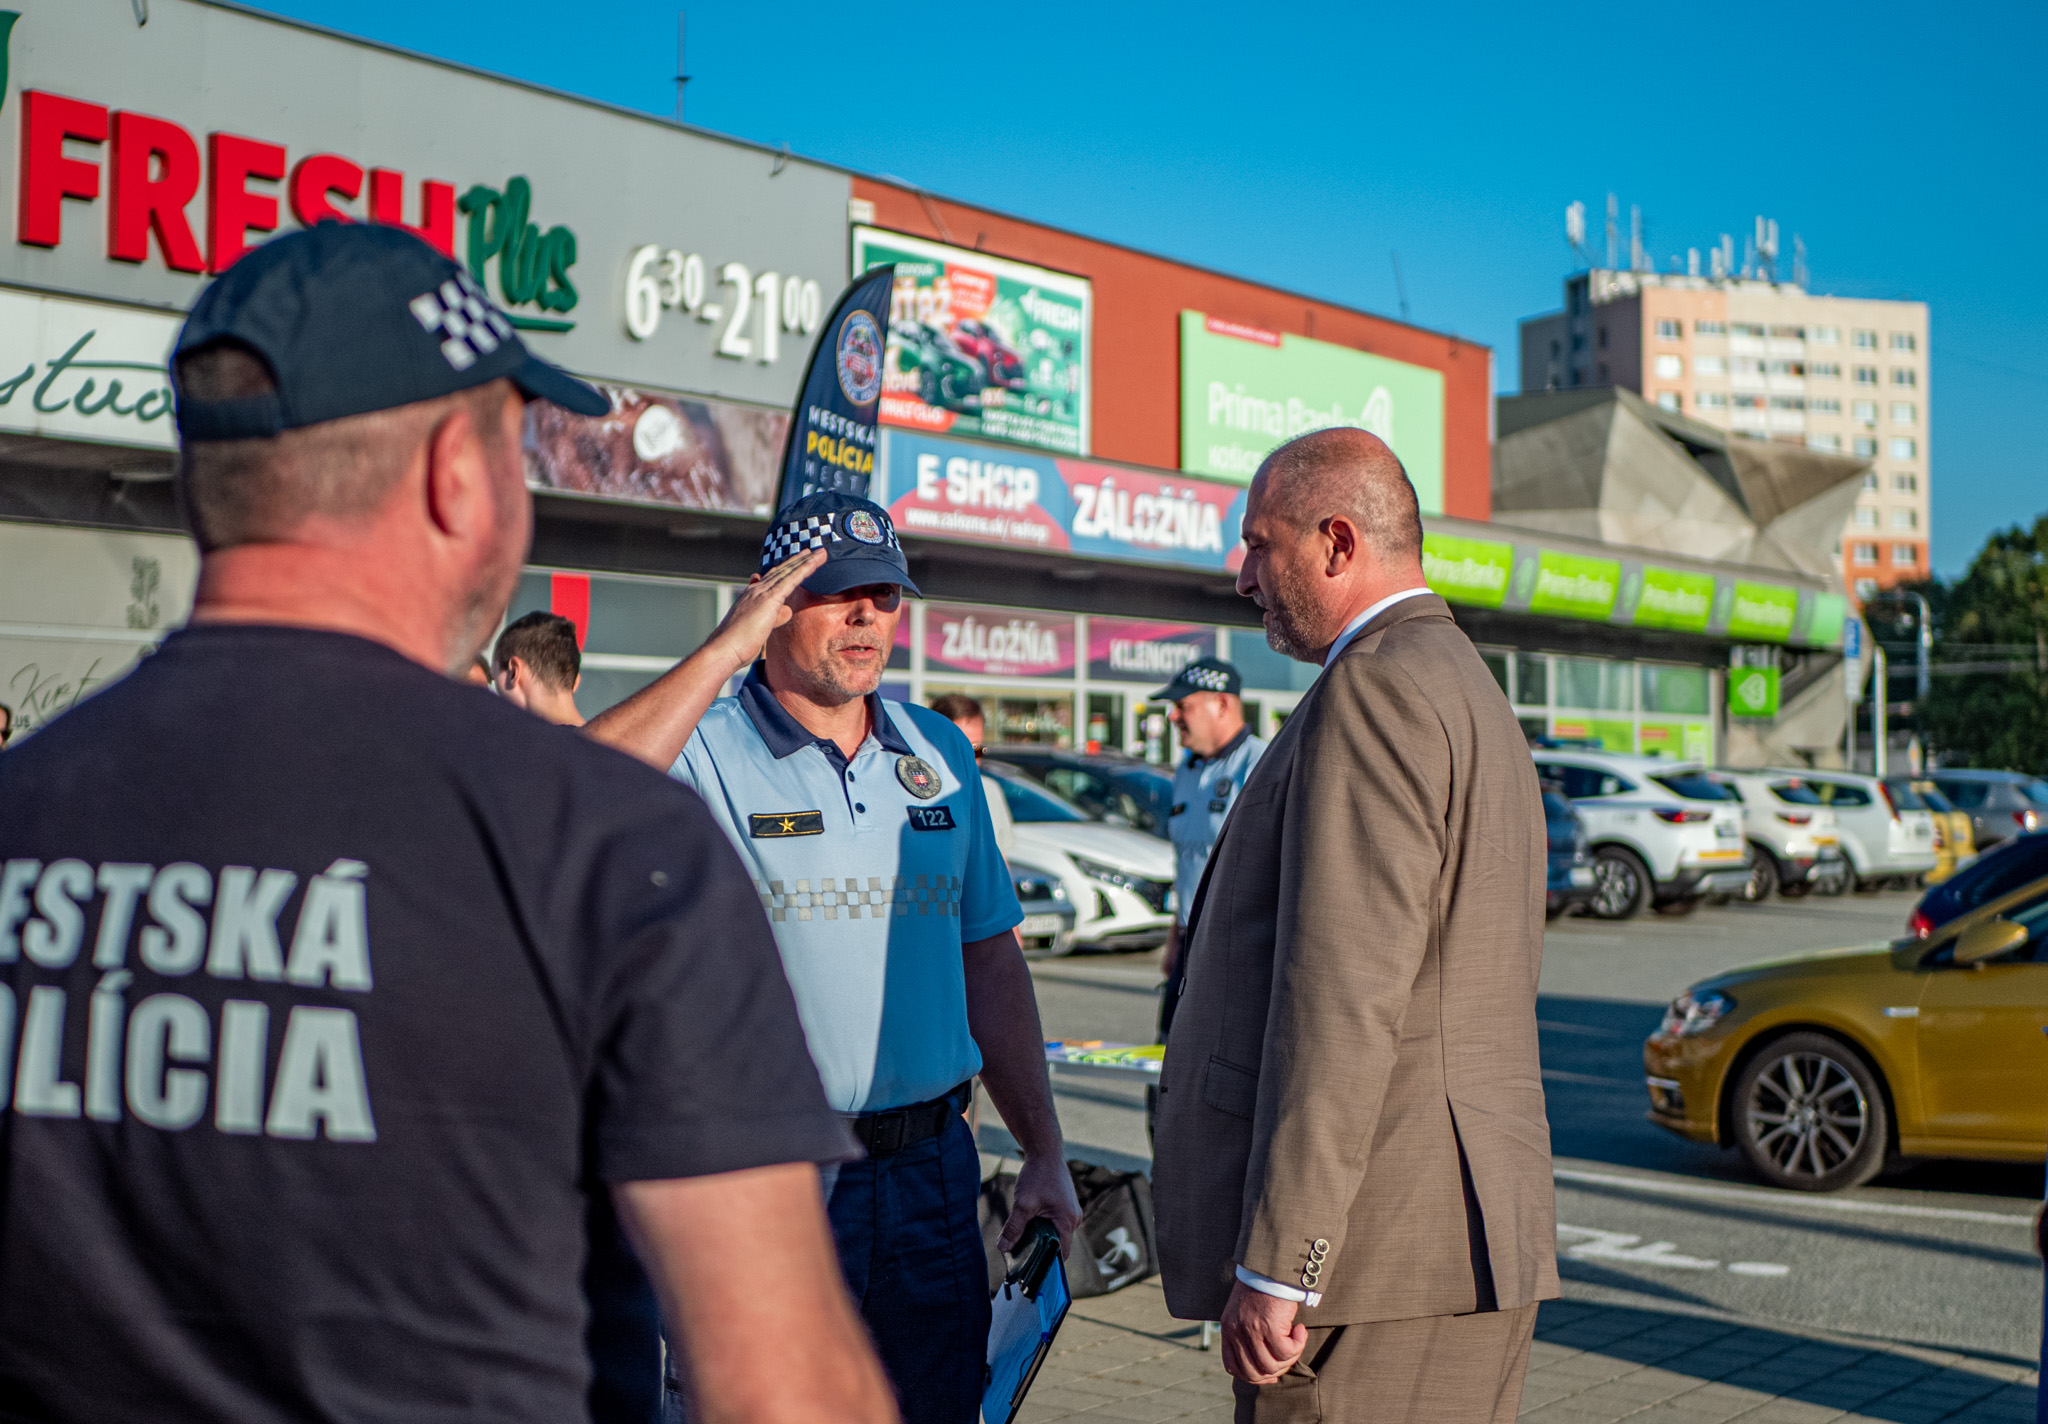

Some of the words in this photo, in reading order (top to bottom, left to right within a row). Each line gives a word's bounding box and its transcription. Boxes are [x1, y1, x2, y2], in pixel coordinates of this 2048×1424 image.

[457, 174, 578, 312] Plus
[1208, 381, 1284, 438] Prima
[806, 430, 873, 474] POLÍCIA
[945, 456, 1039, 513] SHOP
[1072, 475, 1224, 553] ZÁLOŽŇA
[942, 615, 1060, 666] ZÁLOŽŇA
[918, 810, 949, 826] 122
[0, 858, 374, 992] ESTSKÁ
[0, 967, 378, 1142] LÍCIA
